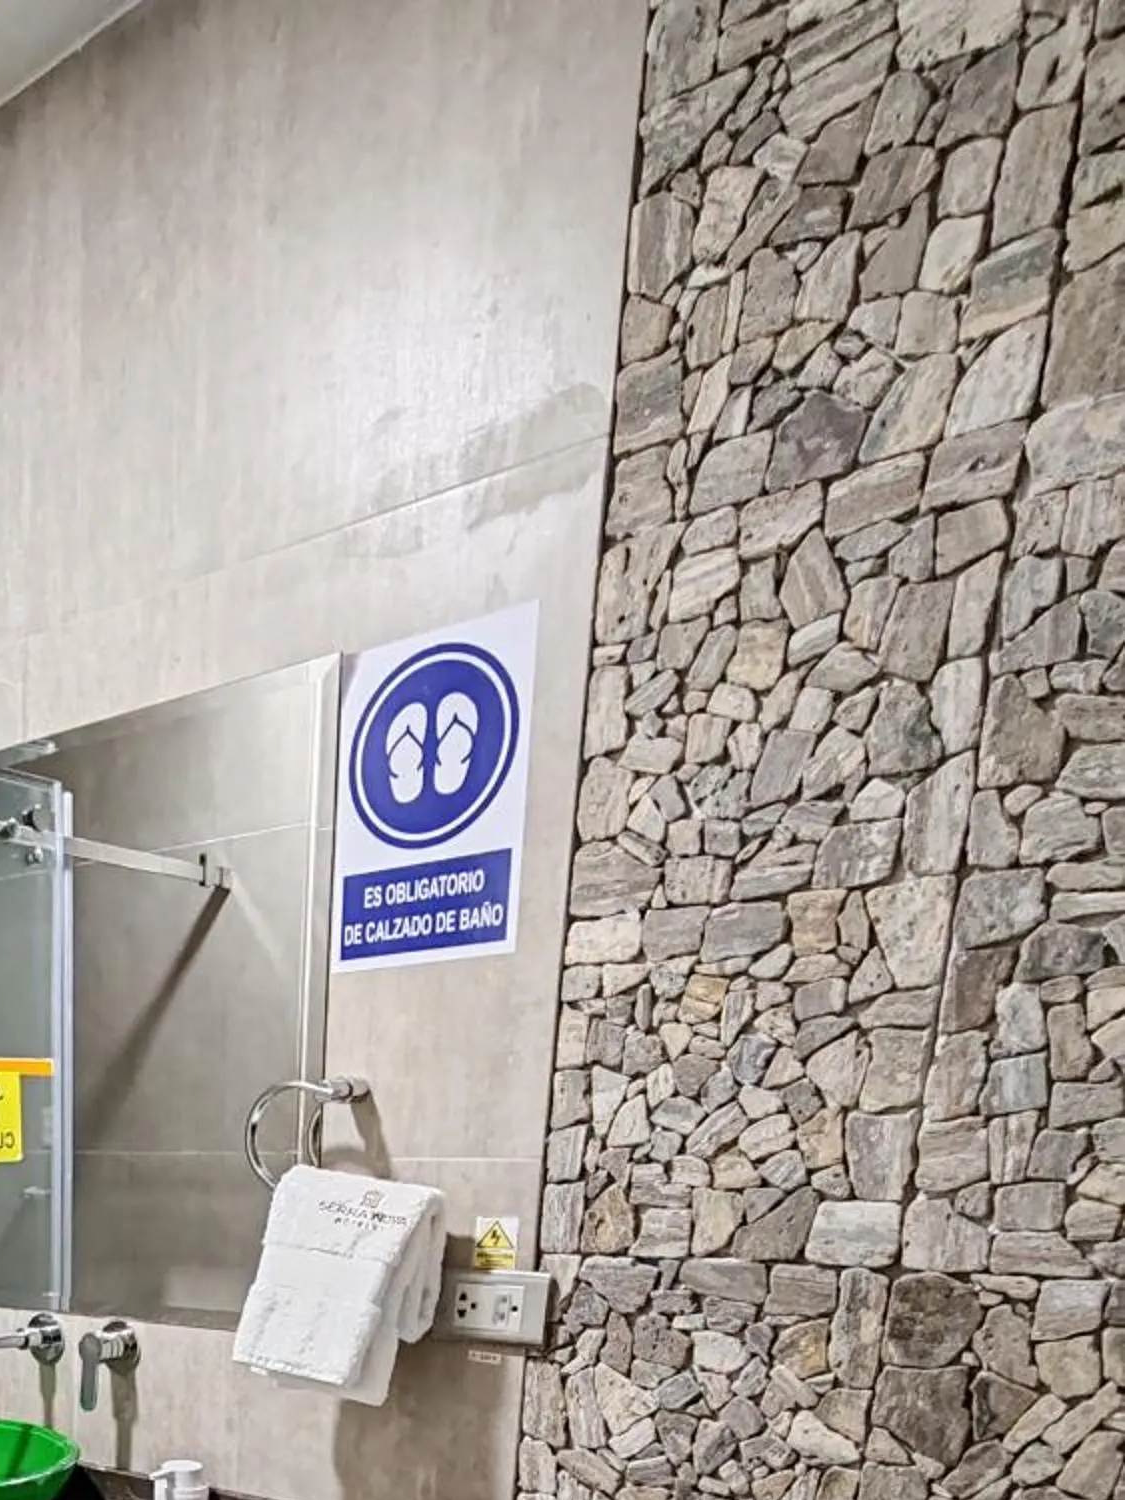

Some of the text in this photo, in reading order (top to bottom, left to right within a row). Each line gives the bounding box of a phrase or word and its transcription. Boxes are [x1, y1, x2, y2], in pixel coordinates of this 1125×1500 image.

[363, 869, 486, 909] ES OBLIGATORIO
[344, 901, 504, 947] DE CALZADO DE BAÑO
